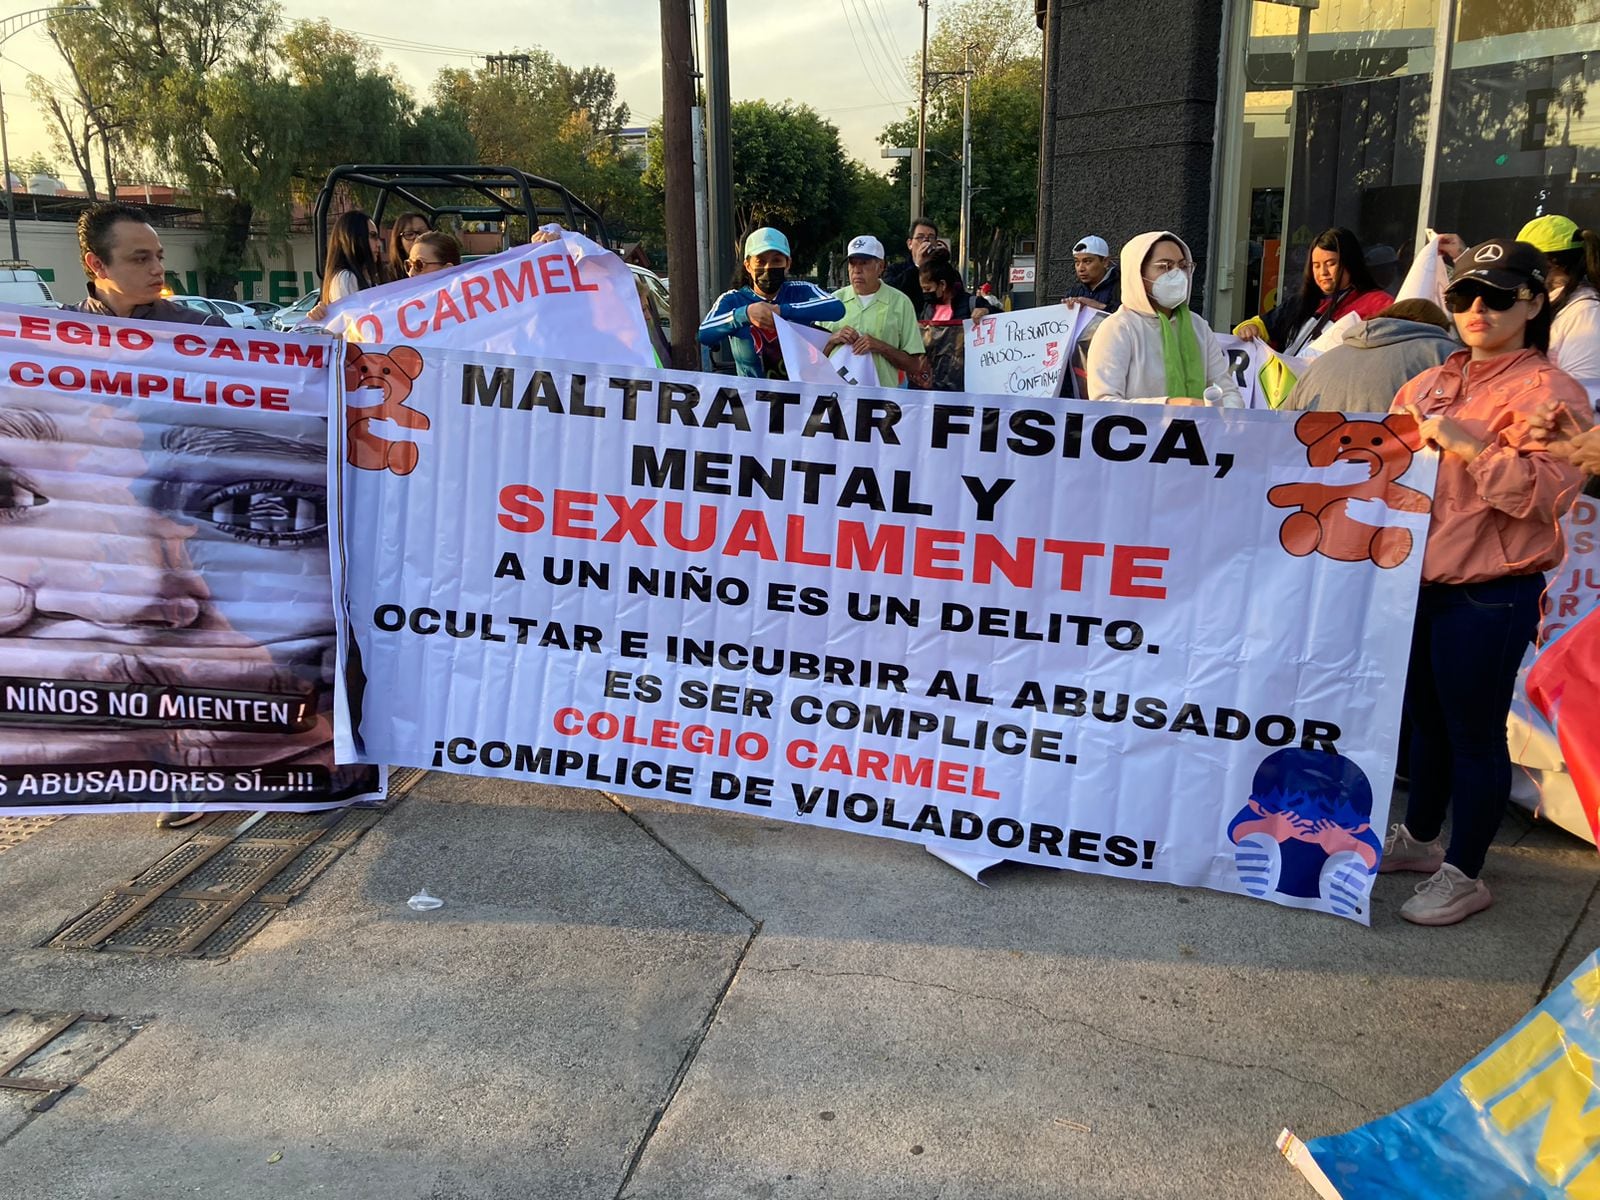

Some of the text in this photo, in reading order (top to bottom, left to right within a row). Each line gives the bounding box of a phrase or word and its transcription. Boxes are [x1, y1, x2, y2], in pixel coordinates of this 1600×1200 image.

[397, 253, 599, 339] CARMEL
[972, 318, 1070, 347] 17 PRESUNTOS
[9, 361, 290, 412] COMPLICE
[173, 334, 331, 369] CARM
[1009, 369, 1061, 393] CONFIRMA
[1042, 341, 1059, 368] 5
[461, 364, 1235, 478] MALTRATAR FISICA,
[631, 445, 1016, 521] MENTAL Y
[497, 484, 1170, 600] SEXUALMENTE
[494, 552, 1160, 655] A UN NIÑO ES UN DELITO.
[6, 682, 98, 715] NIÑOS
[109, 692, 148, 718] NO
[373, 604, 1342, 755] OCULTAR E INCUBRIR AL ABUSADOR
[603, 669, 1077, 765] ES SER COMPLICE.
[17, 768, 225, 796] ABUSADORES
[553, 707, 1001, 800] COLEGIO CARMEL
[431, 737, 1157, 870] ¡COMPLICE DE VIOLADORES!
